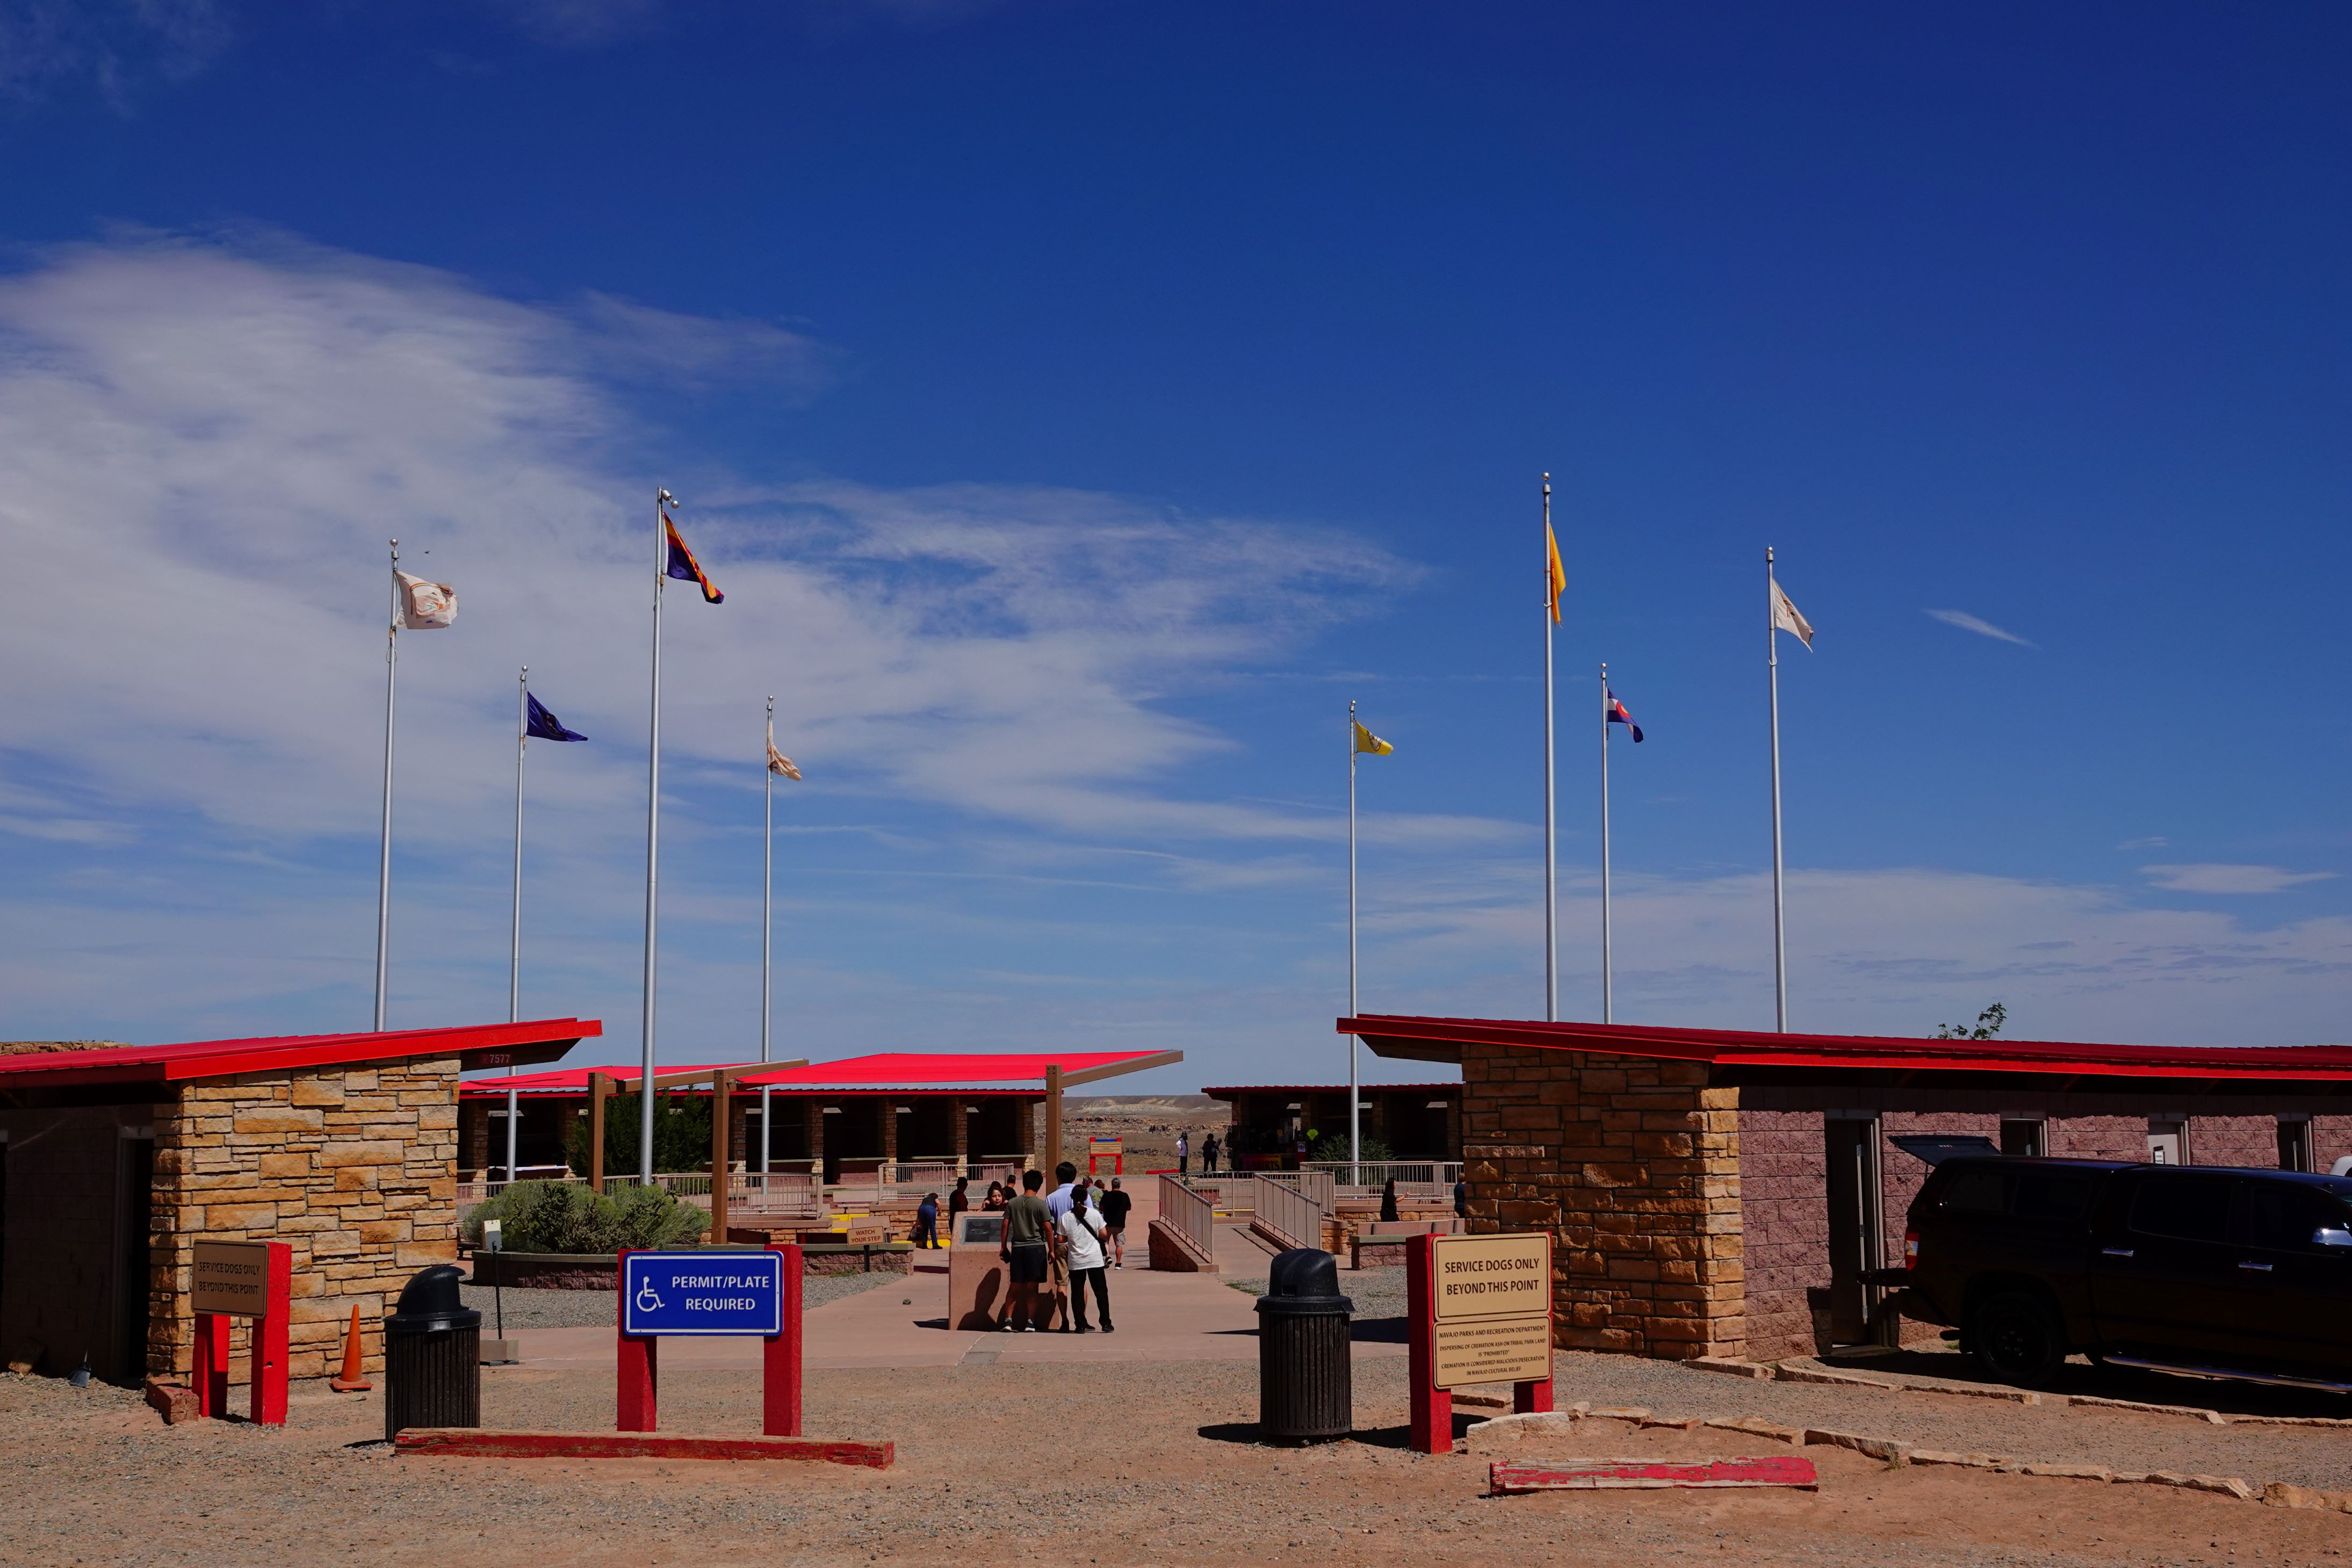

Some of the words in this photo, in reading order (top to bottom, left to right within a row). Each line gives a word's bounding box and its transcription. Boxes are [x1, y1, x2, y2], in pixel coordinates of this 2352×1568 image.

[489, 1054, 510, 1064] 7577
[199, 1262, 223, 1273] SERVICE
[225, 1263, 242, 1274] DOGS
[244, 1265, 260, 1276] ONLY
[1445, 1261, 1483, 1273] SERVICE
[1486, 1259, 1512, 1271] DOGS
[1515, 1258, 1539, 1269] ONLY
[199, 1281, 224, 1292] BEYOND
[225, 1283, 239, 1294] THIS
[240, 1284, 258, 1295] POINT
[672, 1276, 769, 1288] PERMIT/PLATE
[1447, 1282, 1485, 1295] BEYOND
[1487, 1281, 1508, 1293] THIS
[1511, 1280, 1539, 1291] POINT
[686, 1298, 755, 1311] REQUIRED
